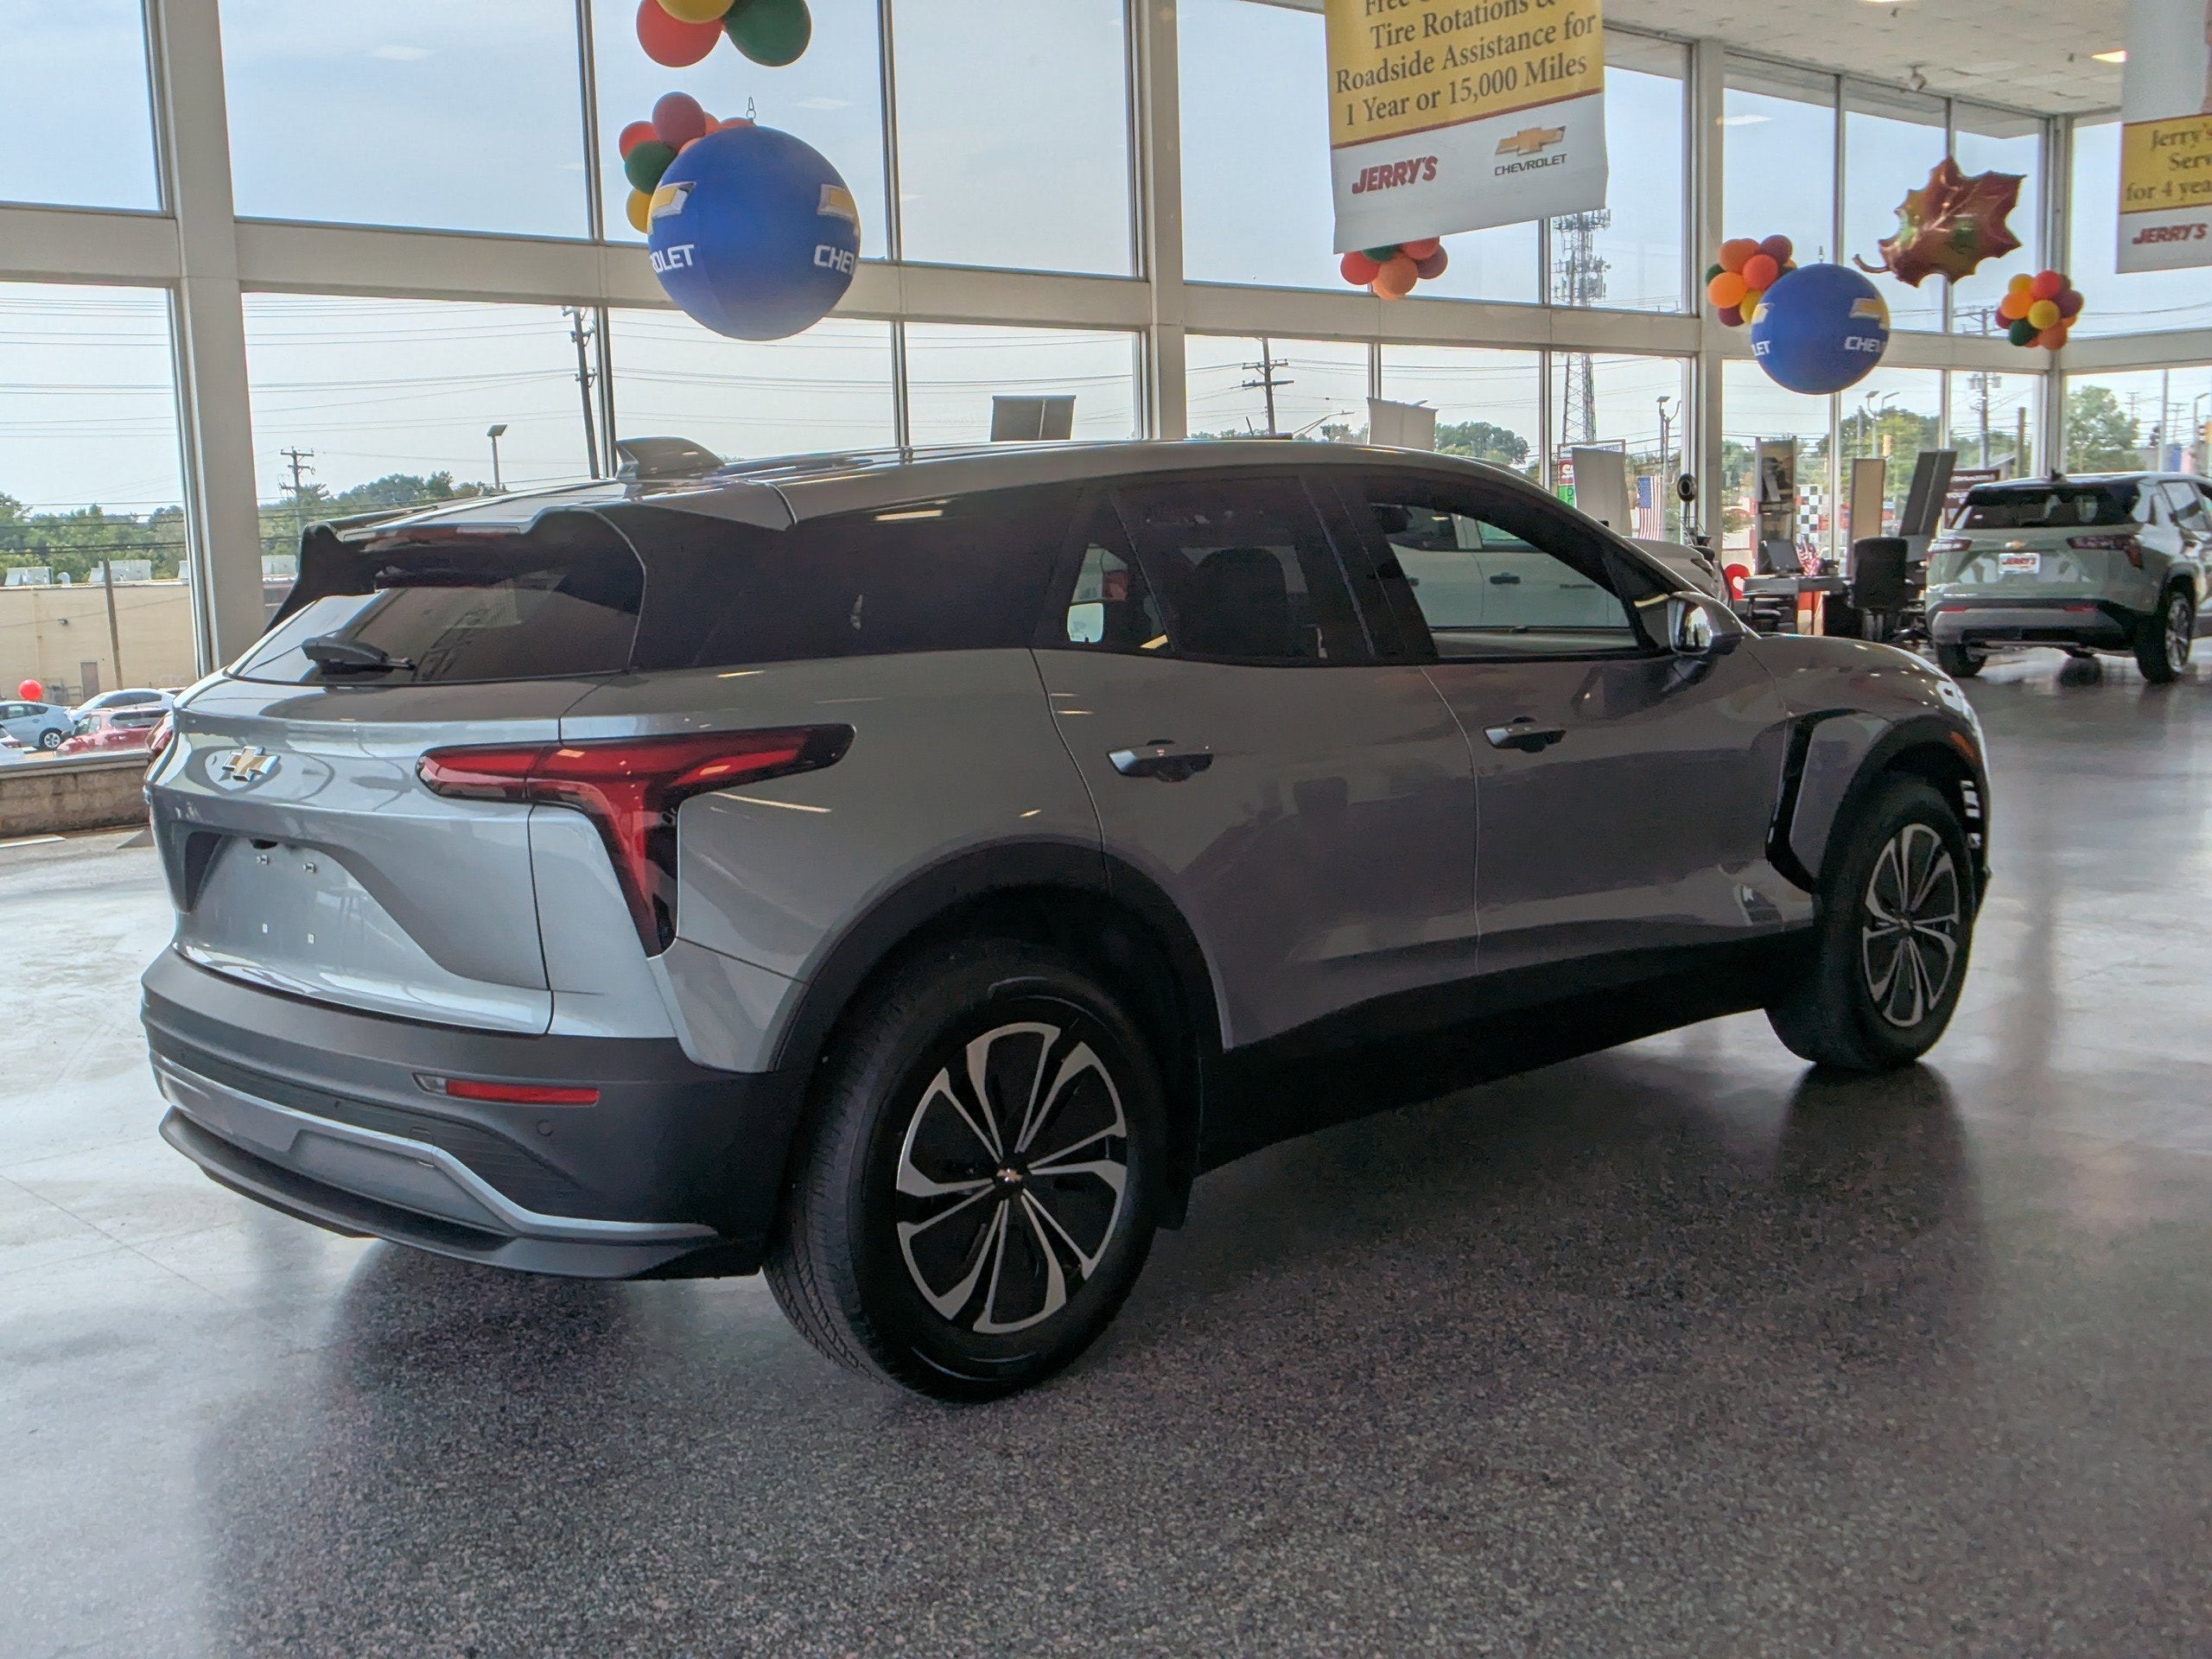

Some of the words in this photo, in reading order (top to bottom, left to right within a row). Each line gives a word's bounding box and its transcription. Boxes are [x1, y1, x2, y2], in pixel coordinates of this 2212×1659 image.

[1370, 23, 1415, 49] Tire
[1422, 0, 1529, 38] Rotations
[1336, 49, 1434, 93] Roadside
[1441, 25, 1556, 71] Assistance
[1564, 11, 1596, 40] for
[1346, 105, 1354, 126] 1
[1363, 96, 1409, 123] Year
[1416, 89, 1440, 111] or
[1449, 67, 1518, 105] 15,000
[1524, 51, 1587, 86] Miles
[1351, 156, 1439, 194] JERRY'S
[1494, 153, 1567, 176] CHEVROLET
[2126, 181, 2156, 200] for
[2132, 223, 2209, 245] JERRY'S
[650, 244, 695, 273] OLET
